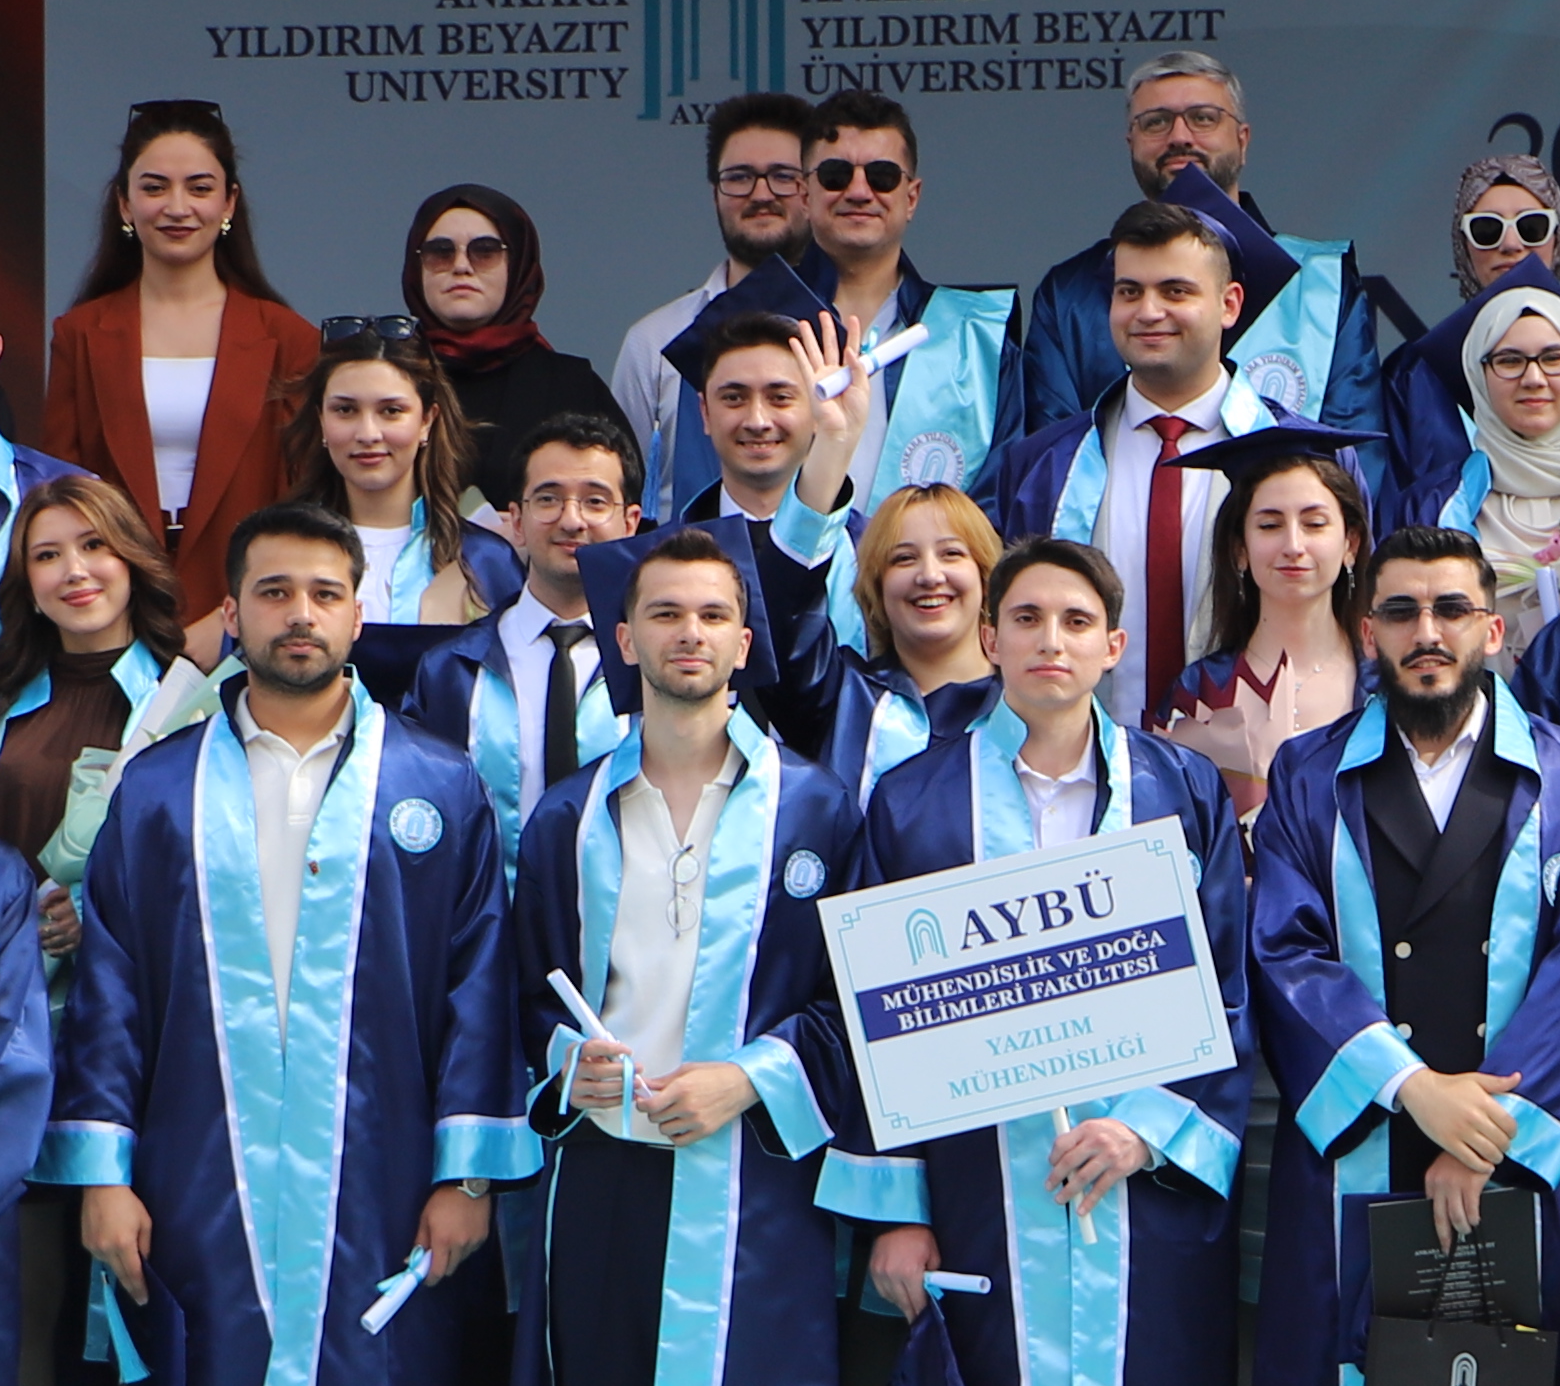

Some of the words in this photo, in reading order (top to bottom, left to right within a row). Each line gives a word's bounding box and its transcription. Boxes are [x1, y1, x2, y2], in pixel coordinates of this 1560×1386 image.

[206, 24, 424, 59] YILDIRIM
[437, 21, 629, 55] BEYAZIT
[801, 13, 1020, 49] YILDIRIM
[1034, 9, 1227, 44] BEYAZIT
[346, 67, 629, 102] UNIVERSITY
[801, 47, 1126, 95] ÜNİVERSİTESİ
[670, 103, 719, 125] AY
[960, 870, 1115, 951] AYBÜ
[880, 953, 1055, 1013] MÜHENDİSLİK
[1058, 944, 1092, 971] VE
[1095, 928, 1166, 962] DOĞA
[897, 982, 1027, 1033] BİLİMLERİ
[1030, 953, 1160, 1002] FAKÜLTESİ
[985, 1015, 1094, 1058] YAZILIM
[947, 1035, 1148, 1100] MÜHENDİSLİĞİ
